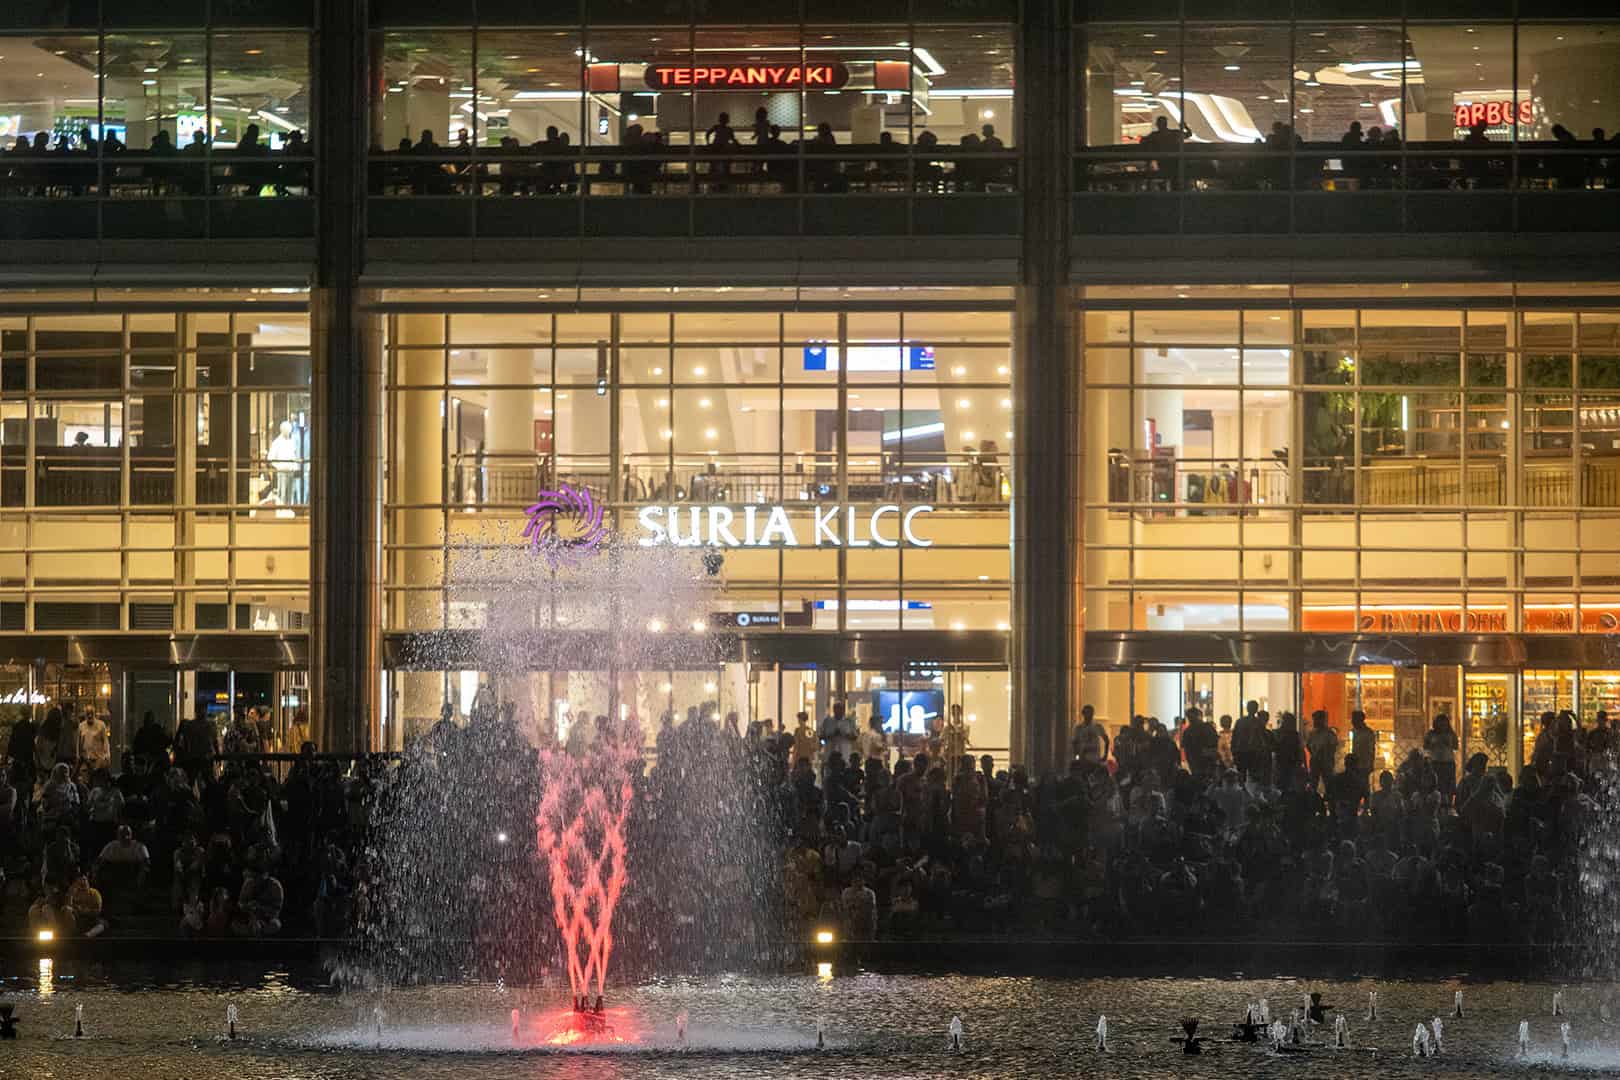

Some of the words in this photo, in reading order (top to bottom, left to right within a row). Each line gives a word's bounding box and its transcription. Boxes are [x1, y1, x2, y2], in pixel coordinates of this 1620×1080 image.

[655, 67, 833, 85] TEPPANYAKI
[638, 505, 797, 547] SURIA
[814, 505, 933, 547] KLCC
